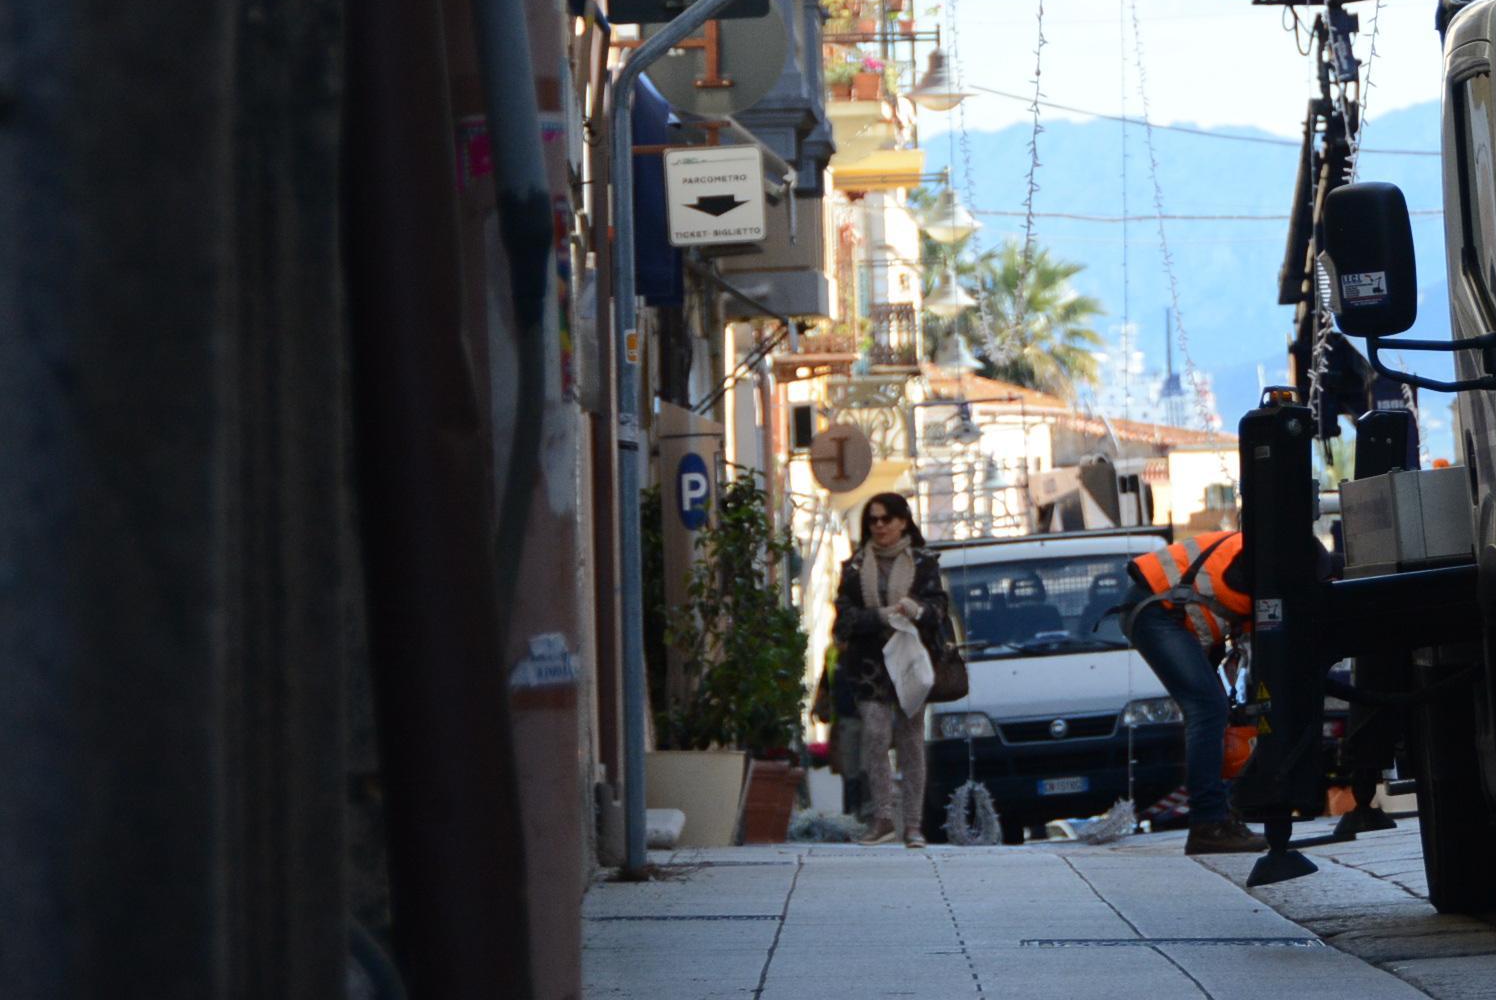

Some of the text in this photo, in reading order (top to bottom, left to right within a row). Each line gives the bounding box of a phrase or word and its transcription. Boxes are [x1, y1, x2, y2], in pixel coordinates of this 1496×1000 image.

[682, 174, 747, 185] PARCOMETRO
[676, 226, 761, 239] TICKET BIGLIETTO
[682, 473, 707, 511] P
